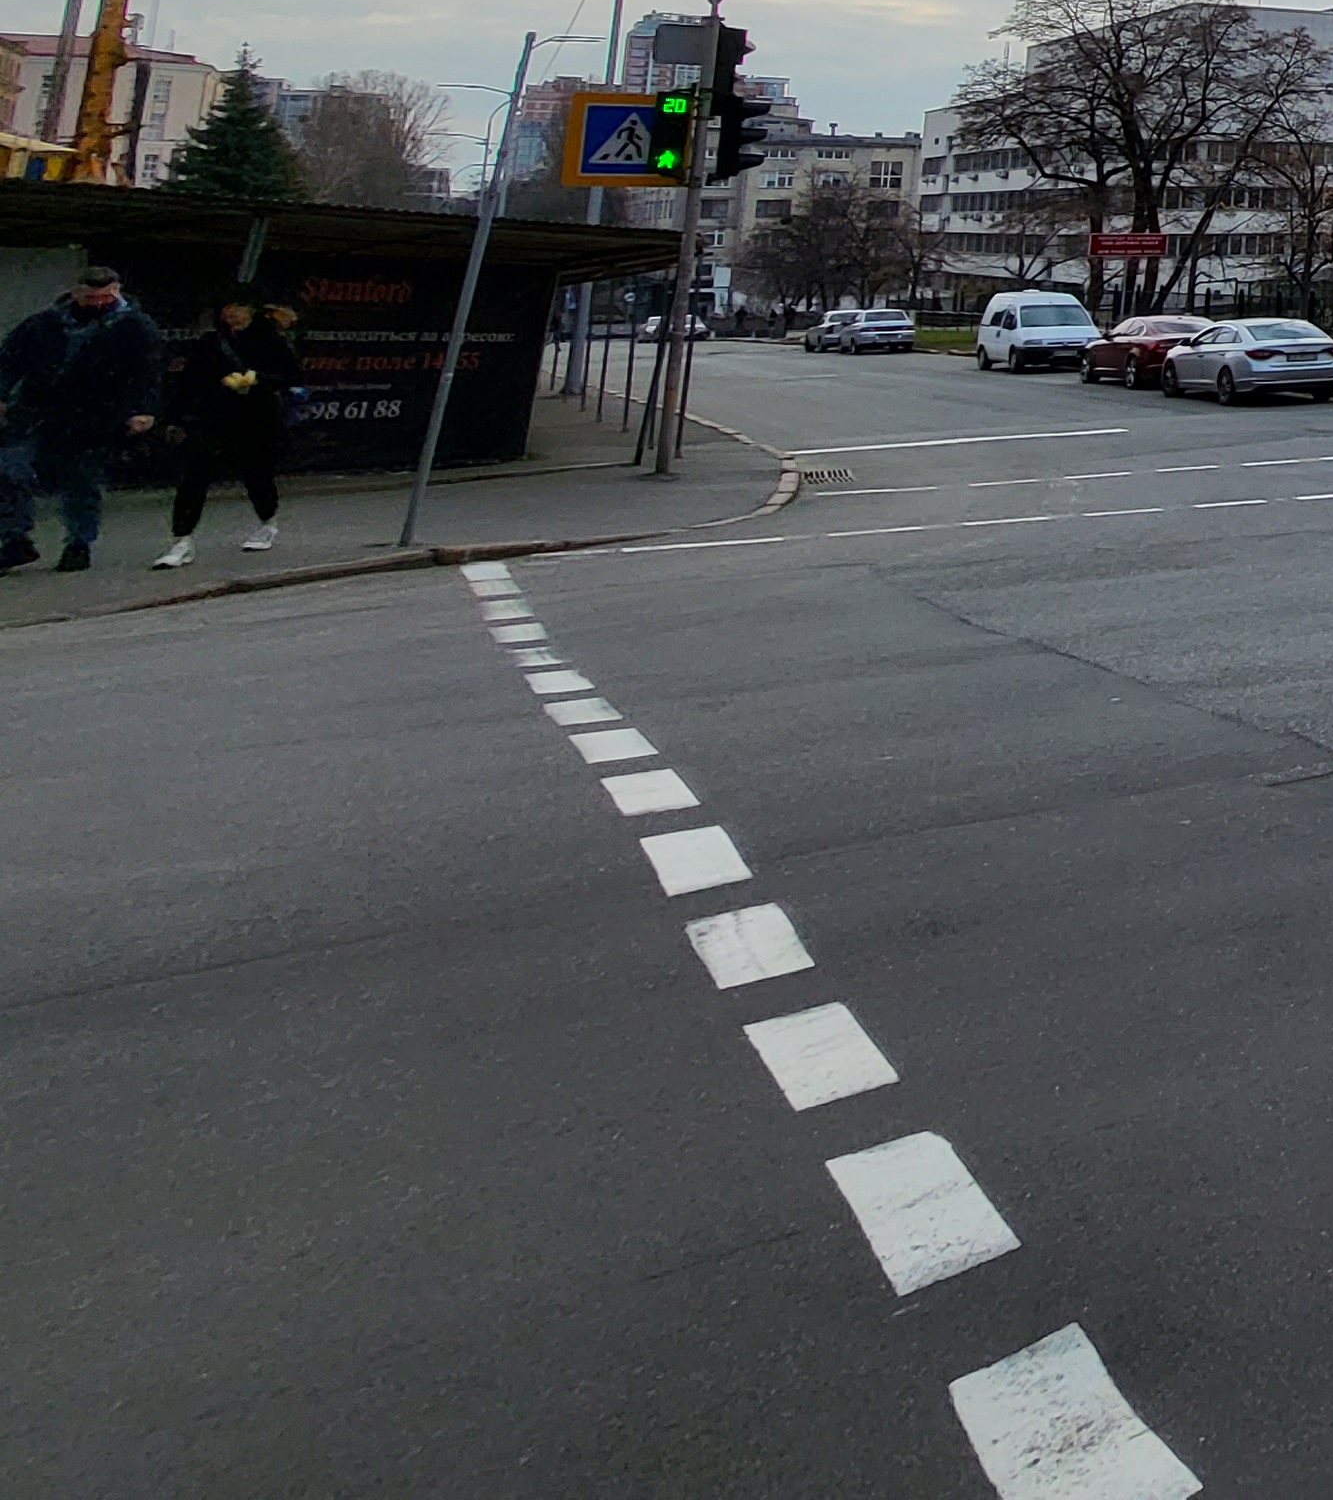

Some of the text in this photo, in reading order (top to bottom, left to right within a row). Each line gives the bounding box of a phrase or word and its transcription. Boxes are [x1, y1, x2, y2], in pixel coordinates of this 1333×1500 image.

[663, 98, 687, 113] 20
[344, 401, 369, 419] 61
[373, 399, 402, 418] 88
